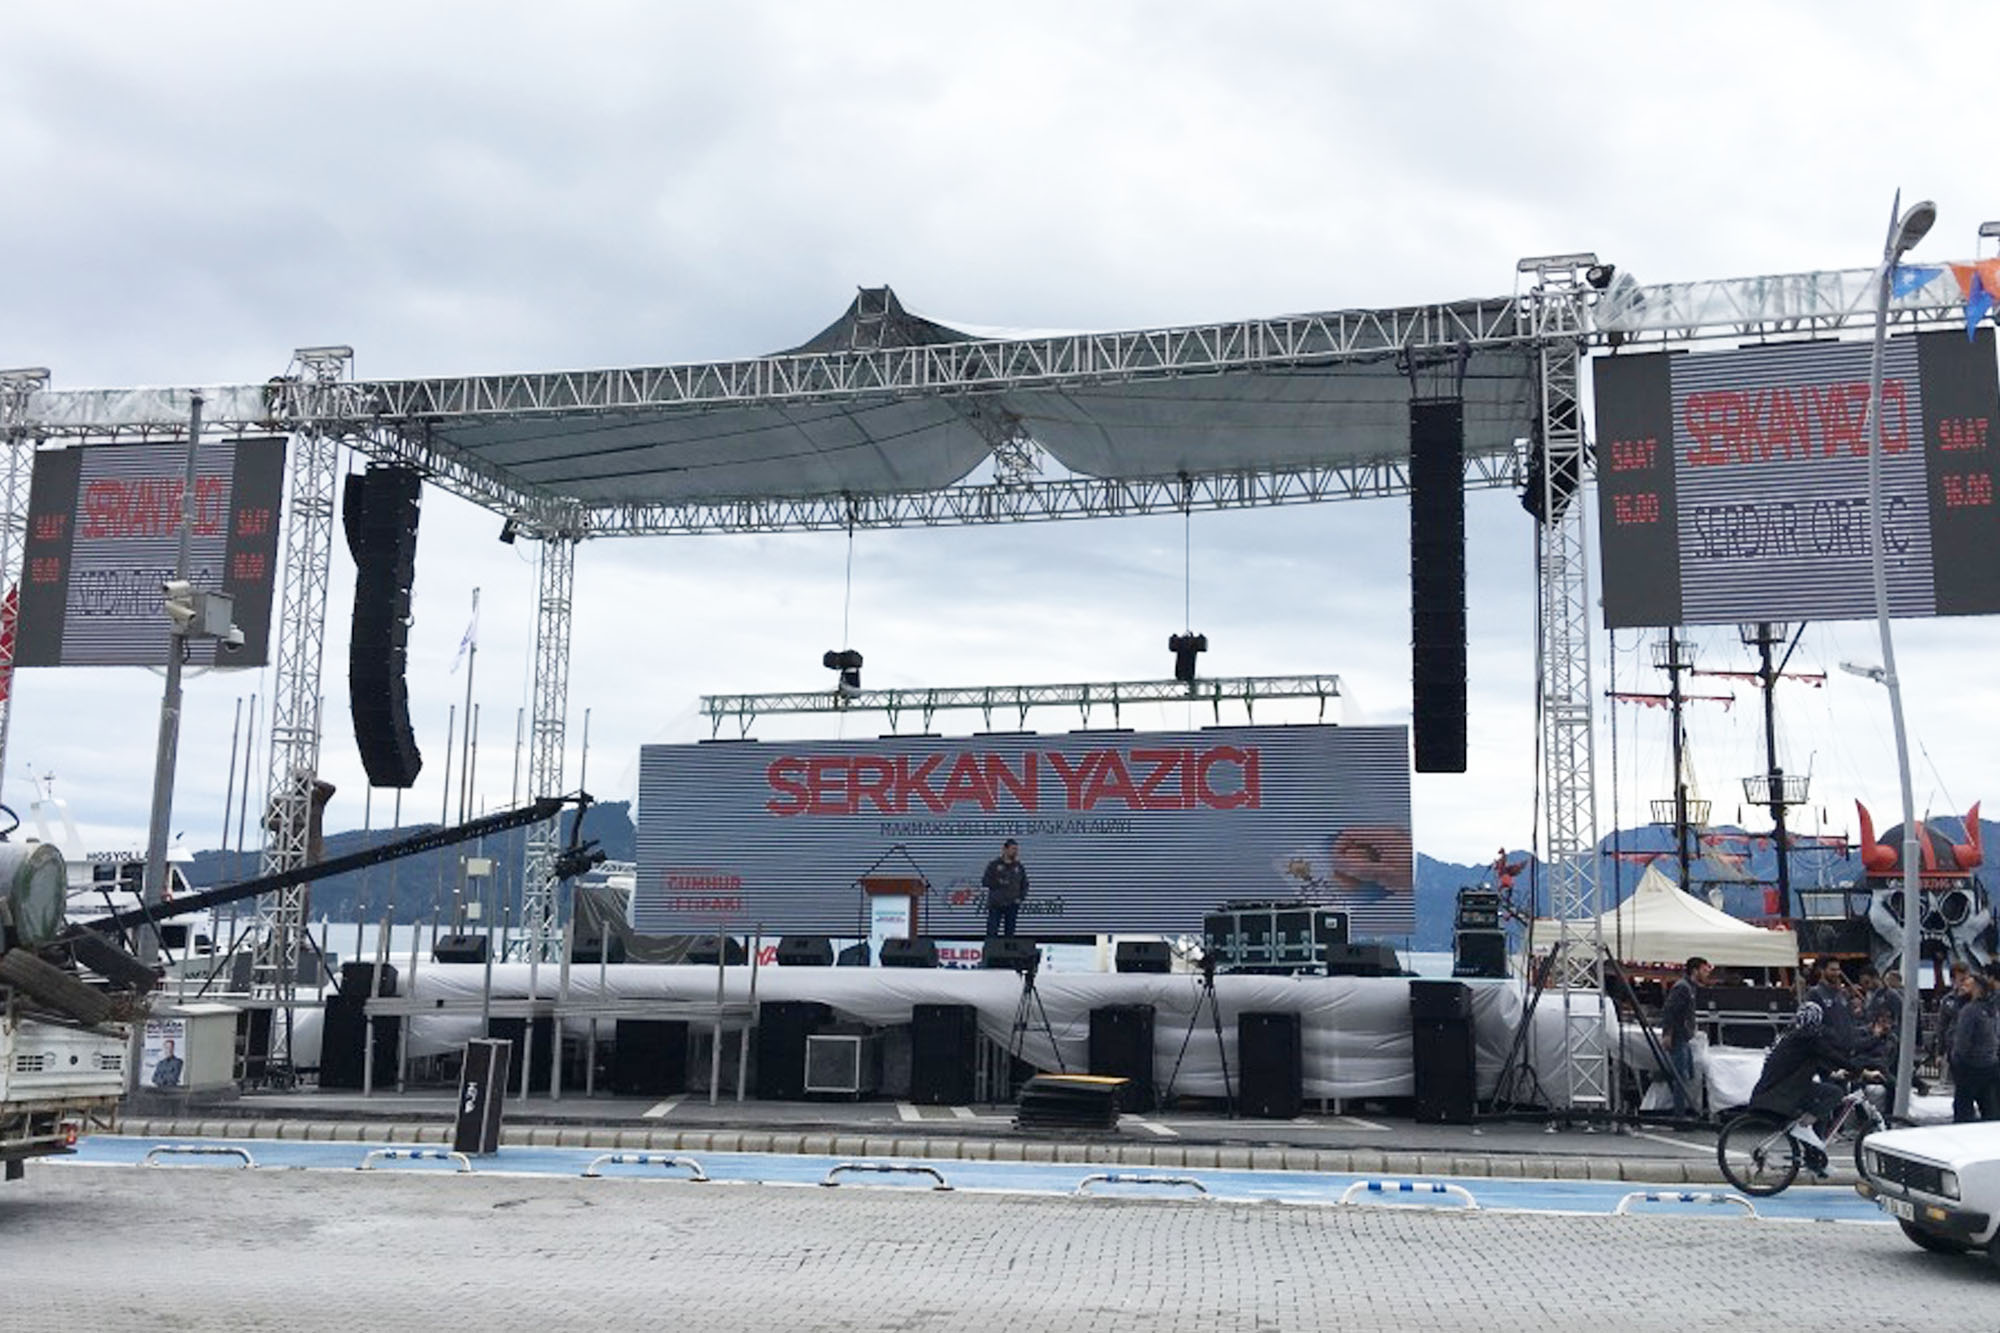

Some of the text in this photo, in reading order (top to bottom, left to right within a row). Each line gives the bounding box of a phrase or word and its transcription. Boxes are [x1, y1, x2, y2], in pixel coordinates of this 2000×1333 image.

[1939, 417, 1988, 450] SAAT
[1611, 438, 1657, 472] SAAT
[765, 745, 1262, 817] SERKAN YAZICI
